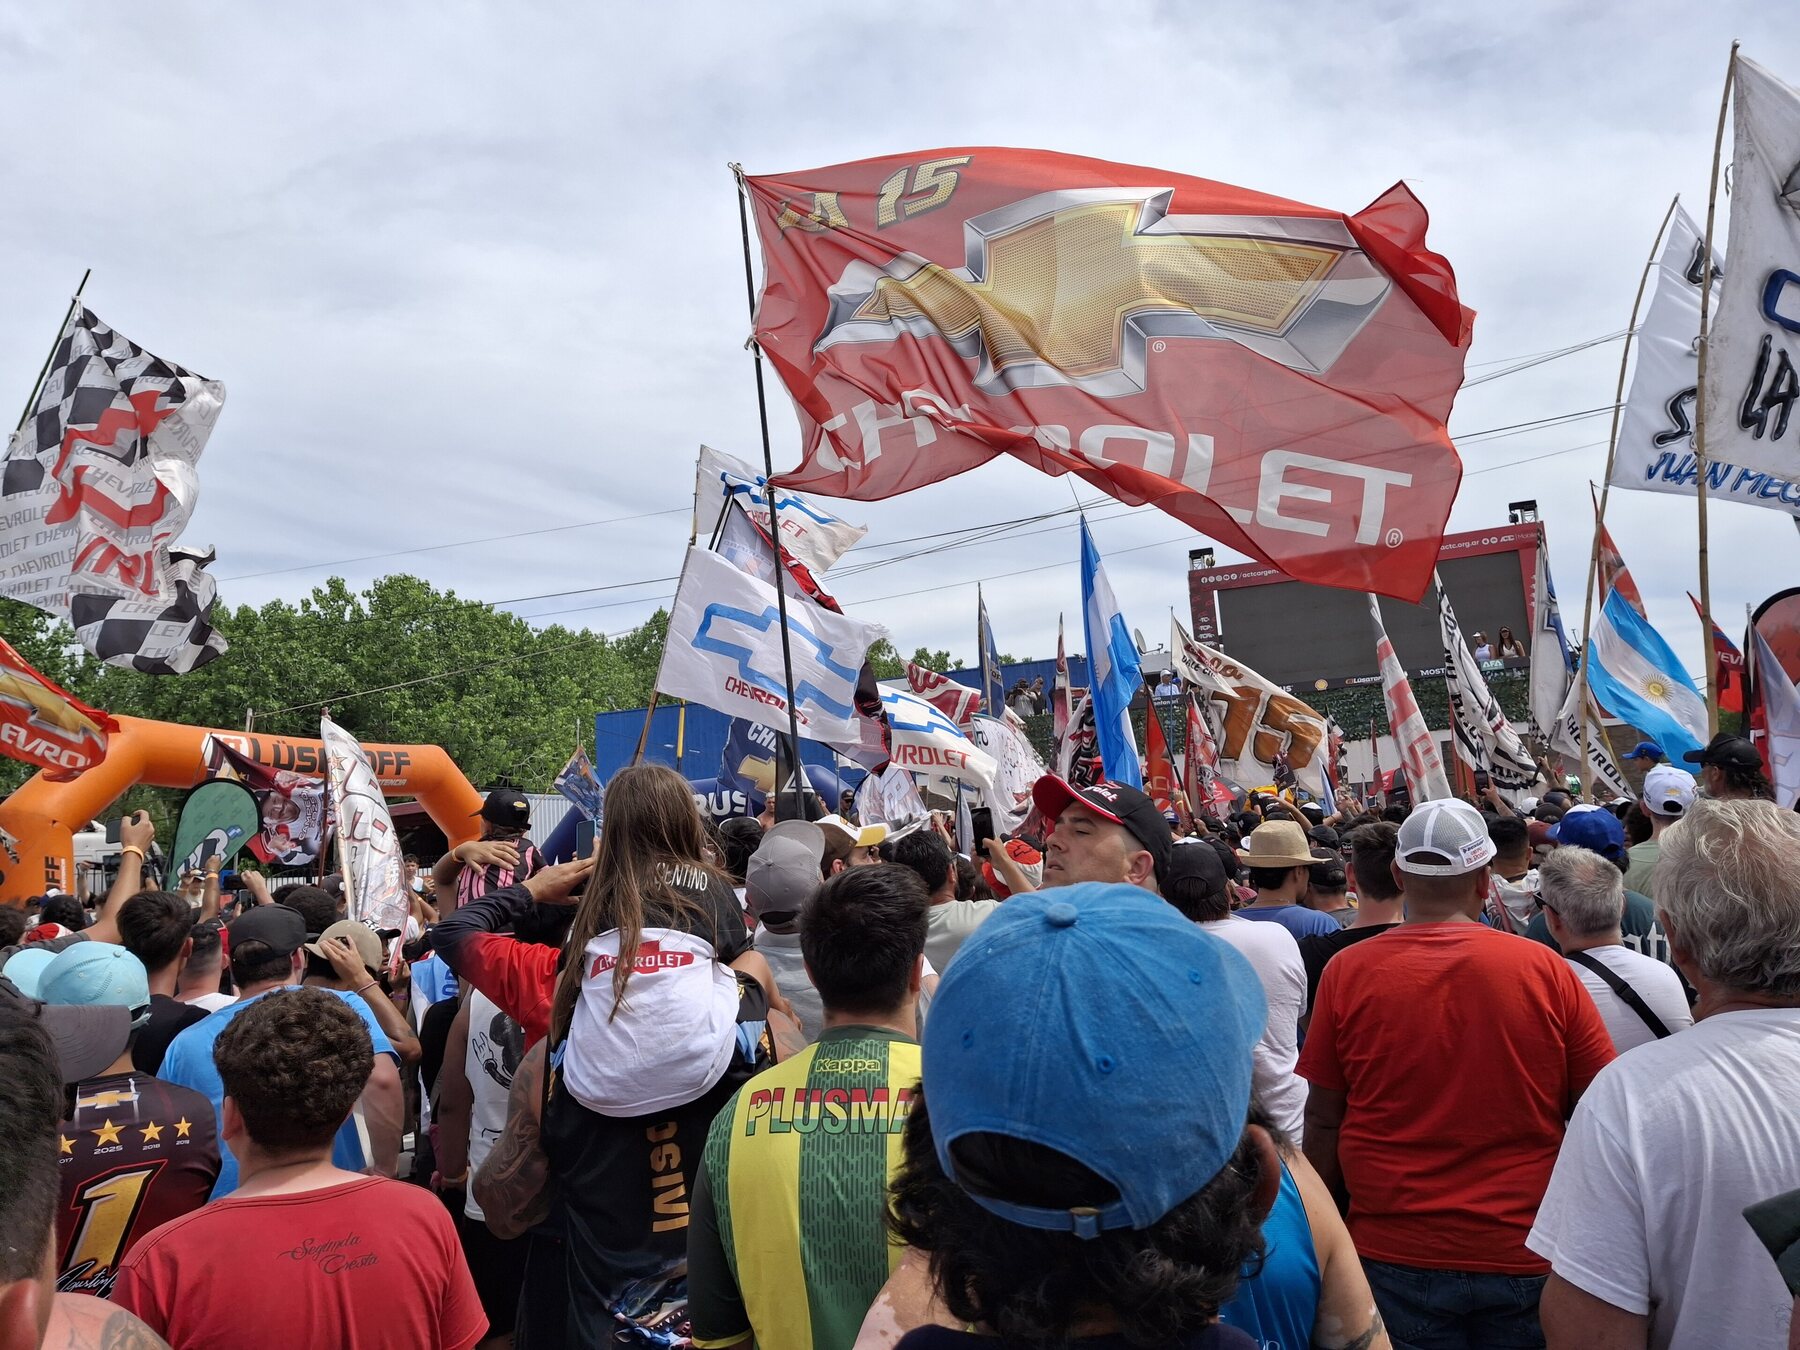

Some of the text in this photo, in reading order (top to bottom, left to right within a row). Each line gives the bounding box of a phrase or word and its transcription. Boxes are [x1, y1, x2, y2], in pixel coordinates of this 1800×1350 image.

[877, 155, 971, 230] 15
[1482, 659, 1504, 670] AFA
[815, 1058, 881, 1073] Kappa
[59, 1156, 74, 1164] 017
[94, 1144, 123, 1155] 2025
[72, 1160, 168, 1272] 1
